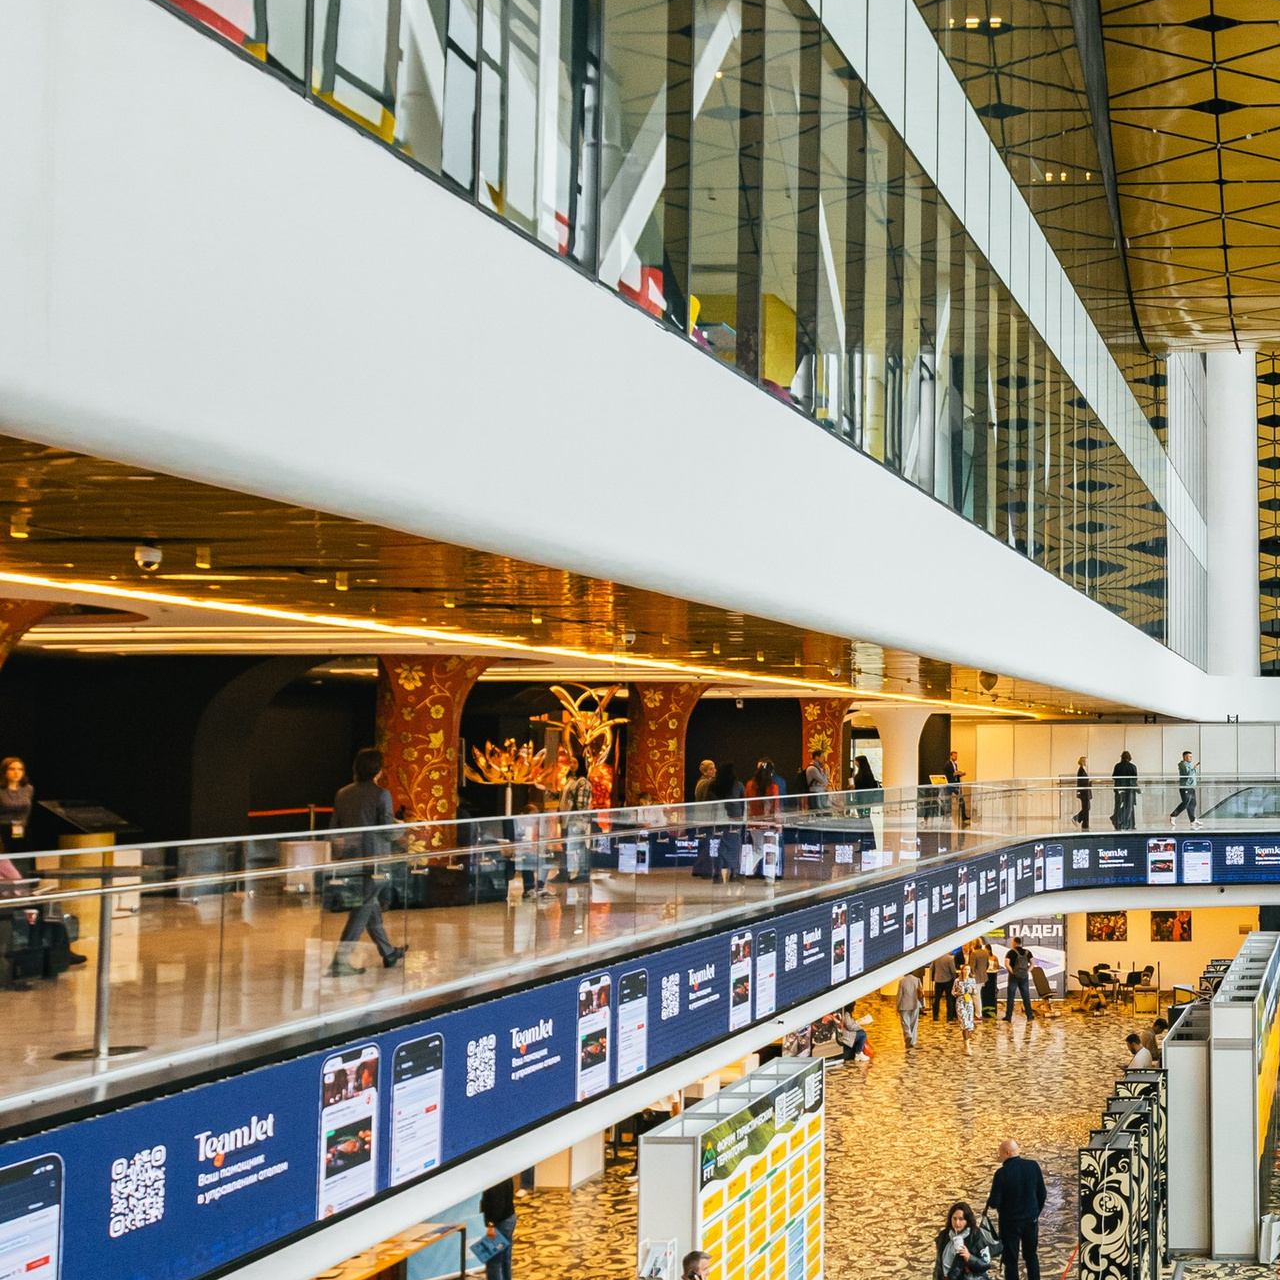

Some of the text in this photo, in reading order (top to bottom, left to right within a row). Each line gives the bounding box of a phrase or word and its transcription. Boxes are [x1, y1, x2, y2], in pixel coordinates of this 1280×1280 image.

[1097, 848, 1128, 857] TeamJet
[1009, 924, 1063, 938] ПАДЕЛ
[688, 963, 716, 986] TeamJet
[510, 1018, 553, 1049] TeamJet
[194, 1113, 274, 1161] TeamJet
[198, 1171, 220, 1187] Ваш
